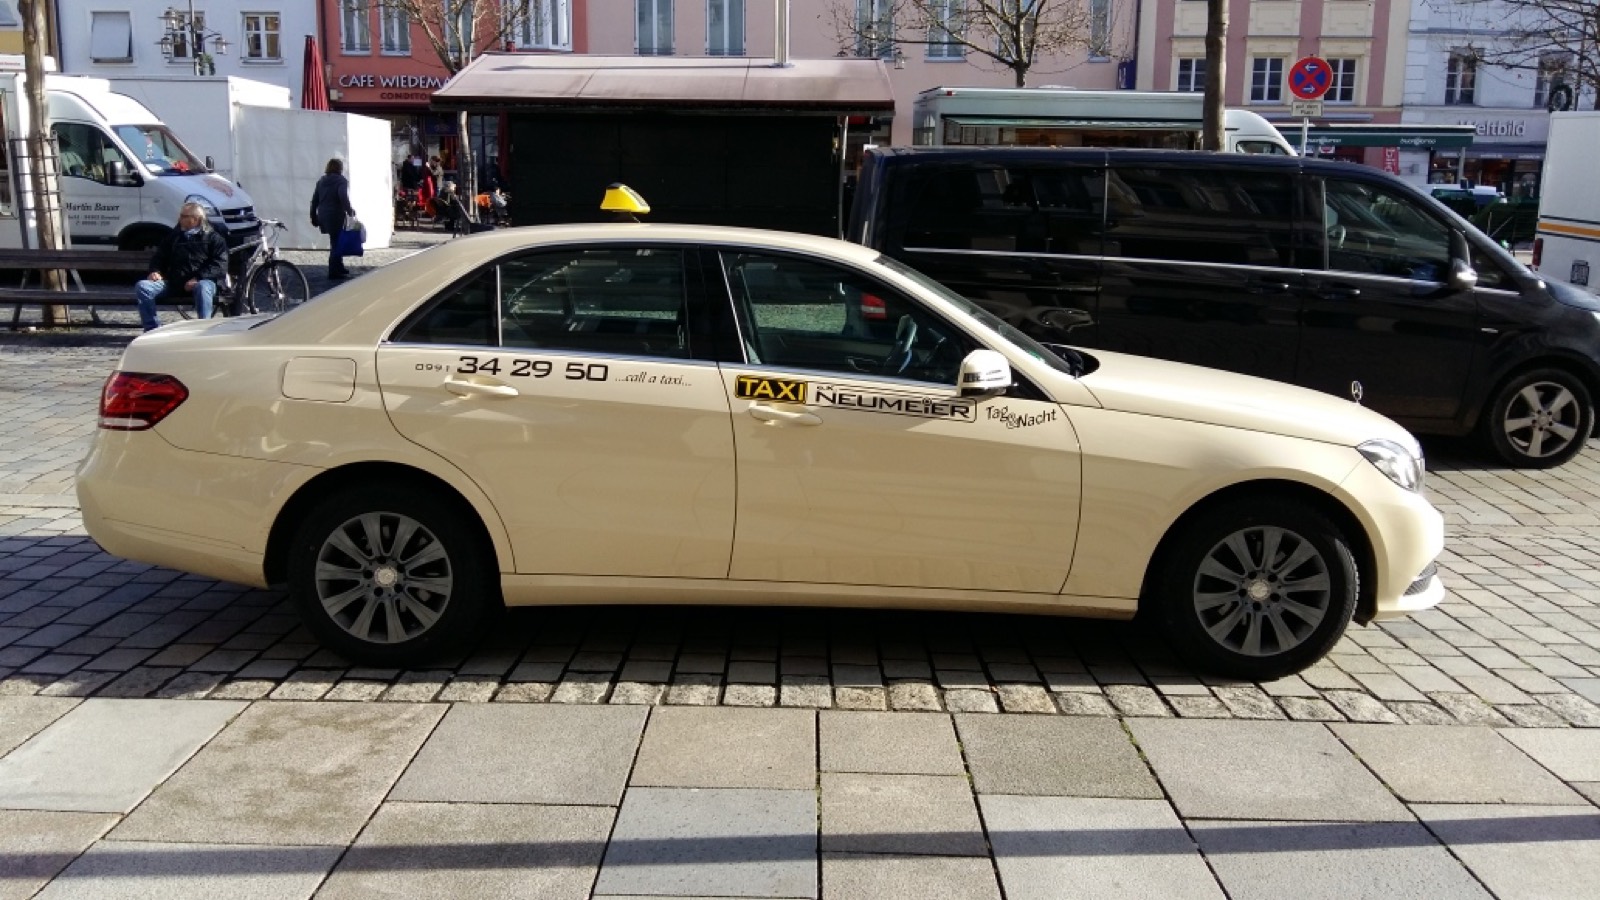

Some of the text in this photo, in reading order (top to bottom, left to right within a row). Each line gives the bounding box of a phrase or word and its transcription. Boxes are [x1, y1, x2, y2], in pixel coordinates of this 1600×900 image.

[340, 75, 374, 87] CAFE
[380, 92, 427, 101] CONDITO
[94, 202, 120, 212] Bauer
[415, 355, 609, 382] 0991 34 29 50
[647, 375, 658, 384] a
[739, 377, 806, 402] TAXI
